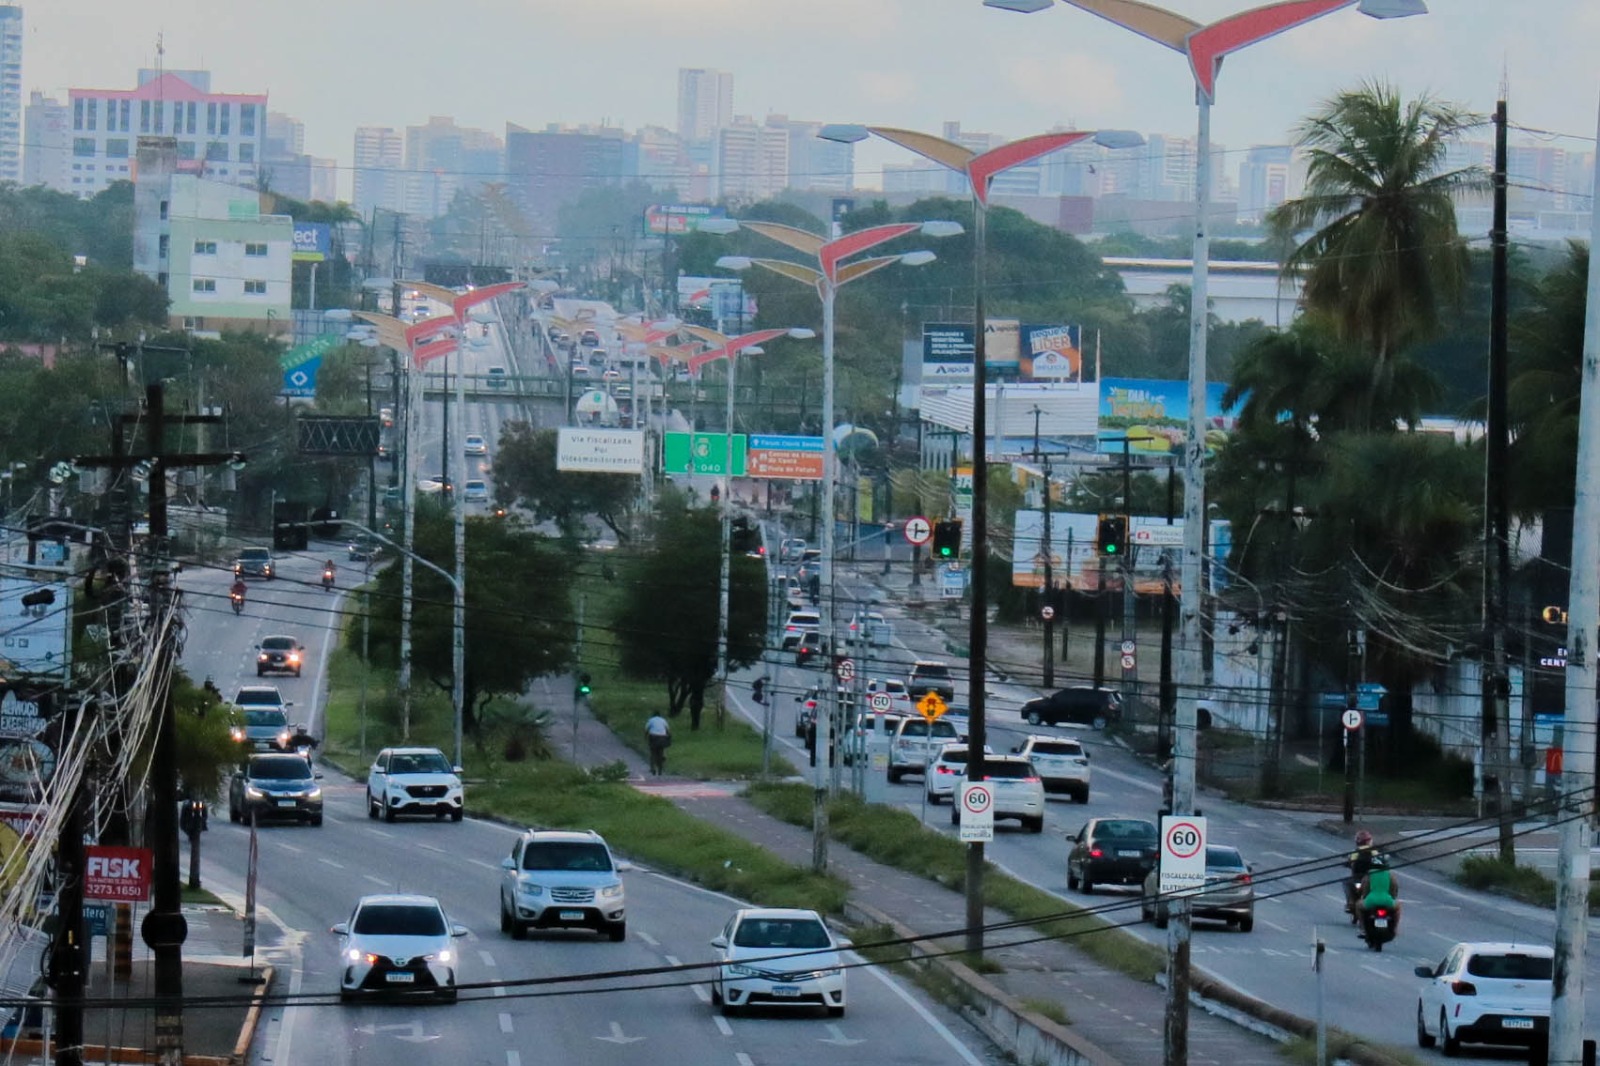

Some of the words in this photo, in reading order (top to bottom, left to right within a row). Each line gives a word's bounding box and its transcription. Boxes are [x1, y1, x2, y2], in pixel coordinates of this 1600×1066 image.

[873, 696, 889, 706] 60
[969, 792, 986, 804] 60
[1173, 831, 1196, 846] 60
[87, 856, 140, 878] FISK
[1161, 871, 1205, 880] FISCALIZAÇÃO
[87, 884, 142, 896] 3273.1650
